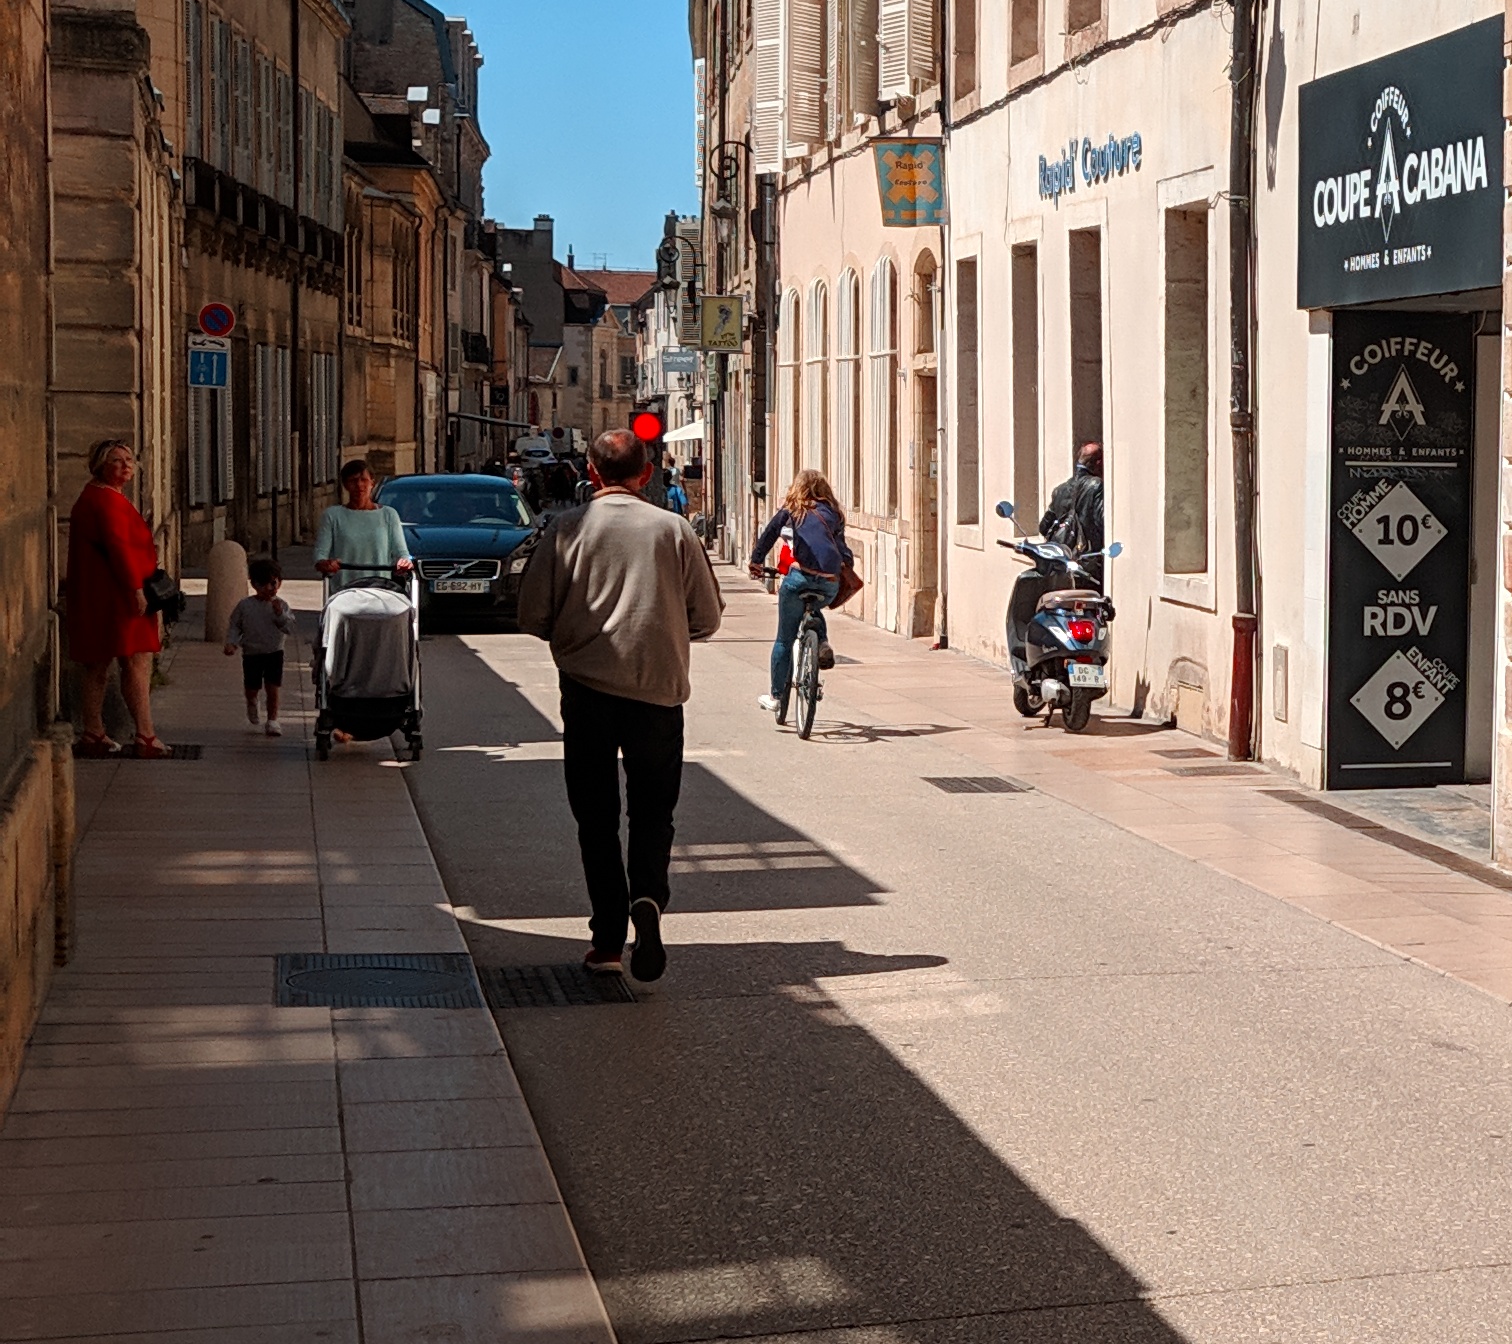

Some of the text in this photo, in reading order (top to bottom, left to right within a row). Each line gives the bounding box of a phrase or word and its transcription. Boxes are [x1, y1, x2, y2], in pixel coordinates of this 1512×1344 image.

[1371, 86, 1409, 132] COIFFEUR
[1082, 131, 1142, 184] Couture
[1313, 169, 1371, 228] COUPE
[1403, 136, 1488, 205] CABANA
[1350, 253, 1380, 271] HOMMES
[1393, 245, 1426, 265] ENFANTS
[1350, 337, 1458, 383] COIFFEUR
[1378, 370, 1426, 425] A
[1347, 447, 1392, 455] HOMMES
[1412, 448, 1456, 456] ENFANTS
[1337, 489, 1366, 519] COUPE
[1342, 478, 1392, 529] HOMME
[1377, 590, 1420, 604] SANS
[1363, 605, 1438, 636] RDV
[1406, 646, 1455, 695] ENFANT
[1433, 657, 1460, 690] COUPE
